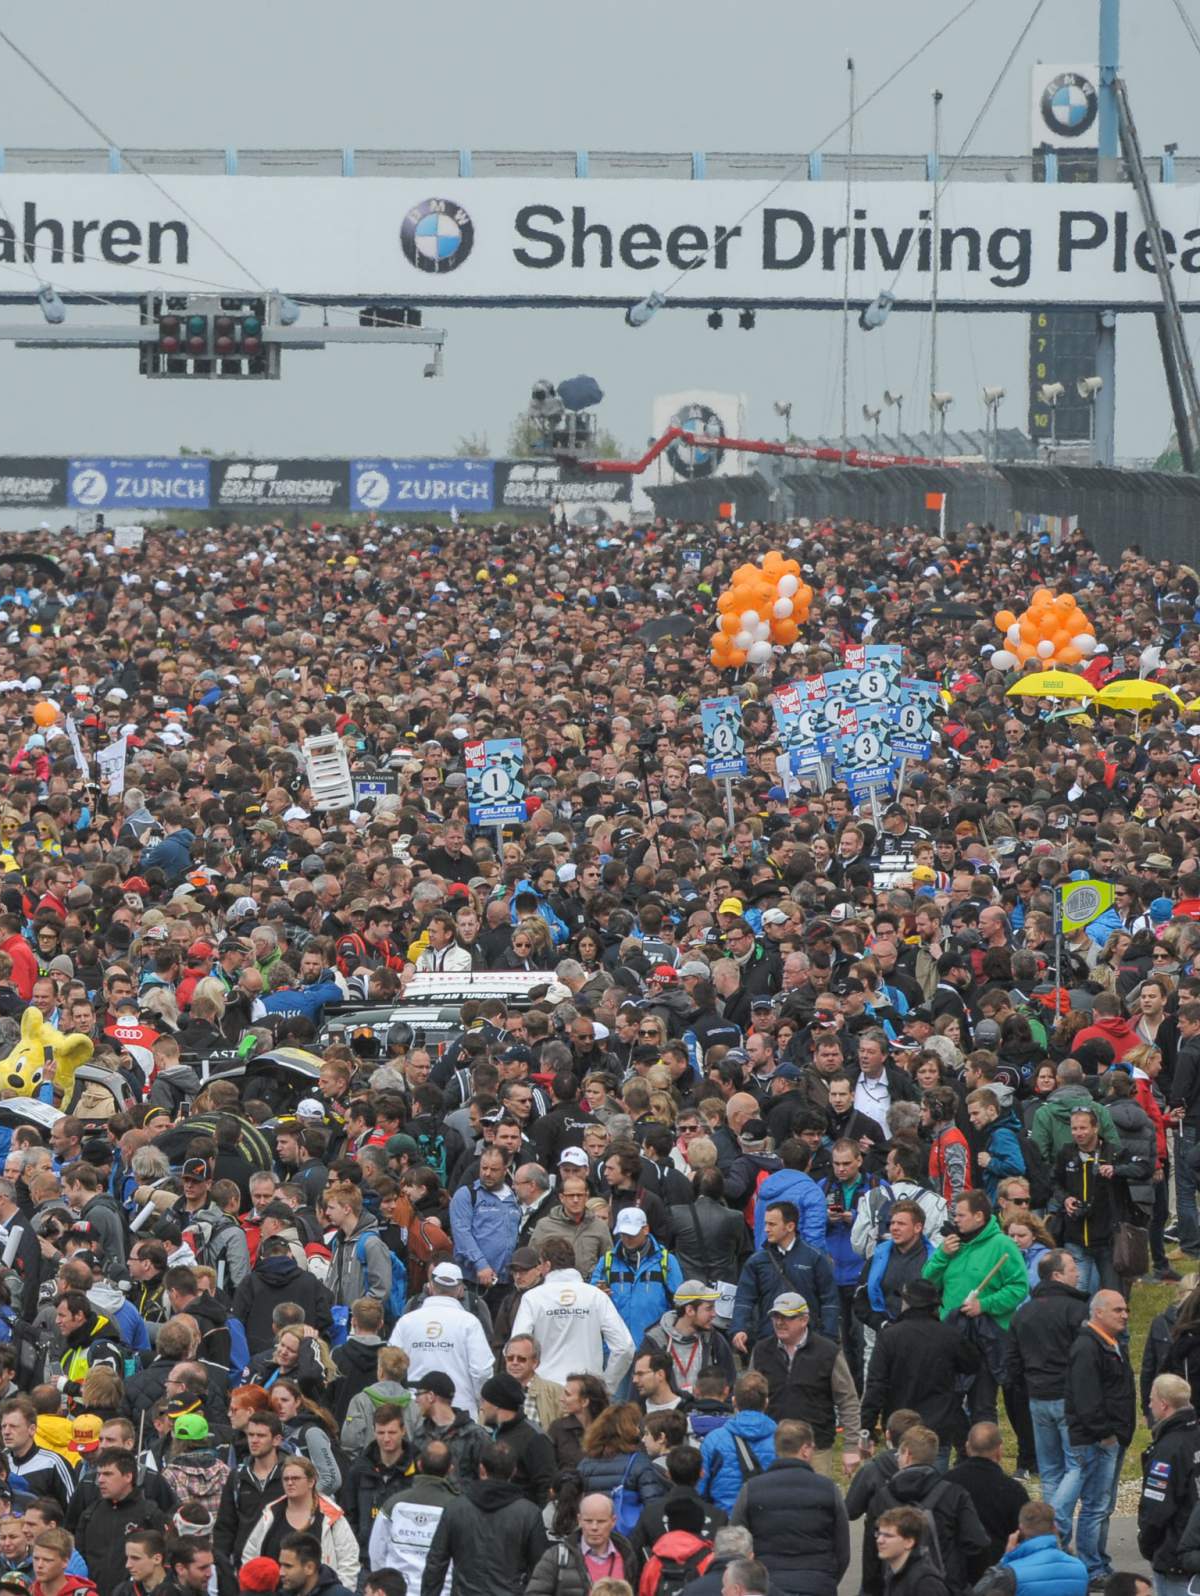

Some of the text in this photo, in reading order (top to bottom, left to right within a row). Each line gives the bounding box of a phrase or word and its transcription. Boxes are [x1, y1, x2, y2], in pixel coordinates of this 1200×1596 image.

[513, 204, 742, 271] Sheer
[762, 208, 1031, 288] Driving
[1034, 414, 1048, 427] 10
[115, 478, 205, 498] ZURICH
[397, 480, 489, 500] ZURICH
[869, 676, 878, 692] 5
[834, 702, 842, 719] 7
[905, 710, 914, 728] 6
[720, 730, 727, 747] 2
[862, 737, 871, 755] 3
[851, 767, 890, 778] FALKEN
[492, 773, 498, 792] 1
[476, 806, 521, 816] FALKEN
